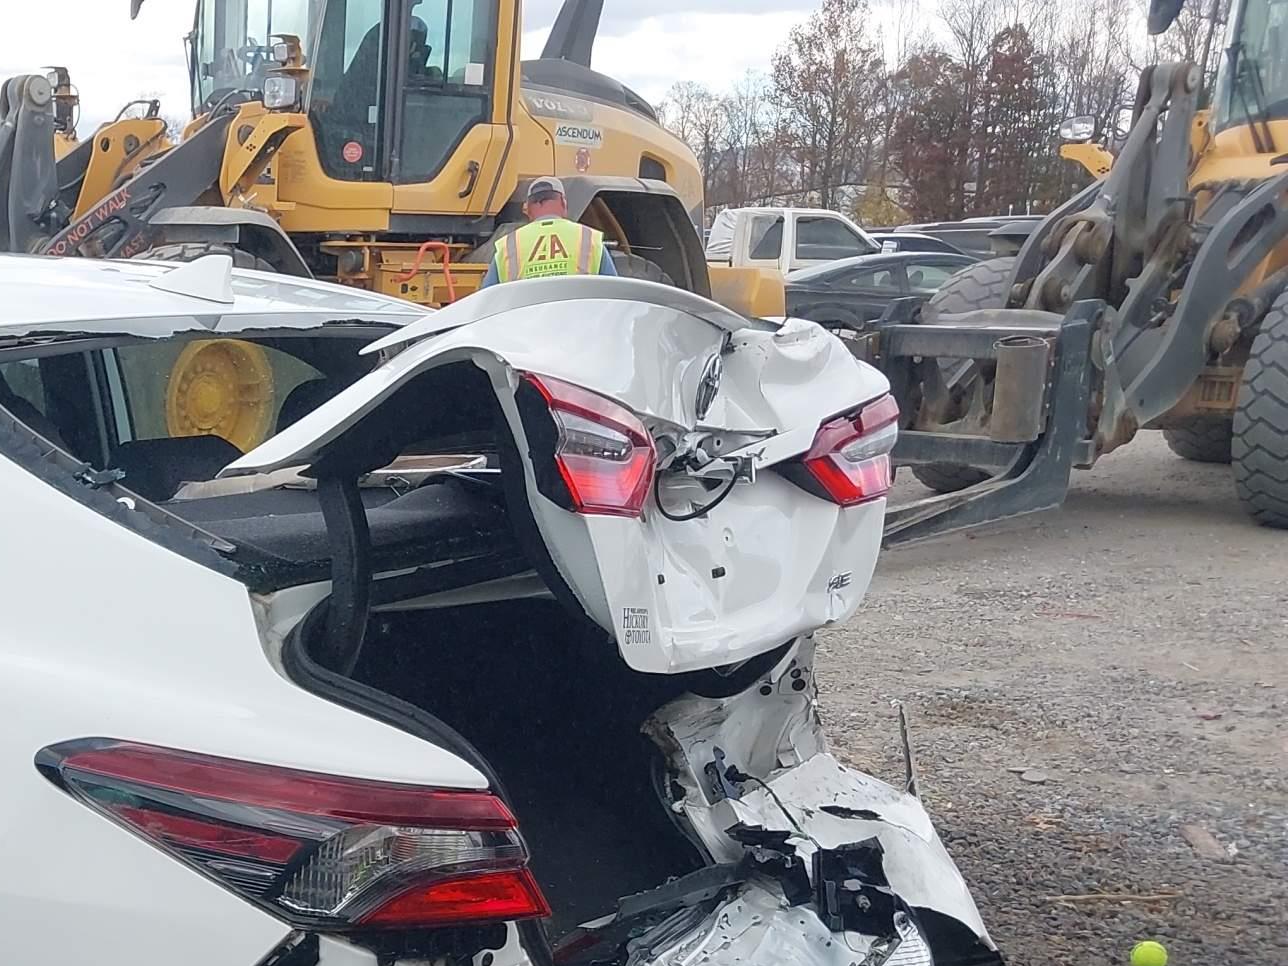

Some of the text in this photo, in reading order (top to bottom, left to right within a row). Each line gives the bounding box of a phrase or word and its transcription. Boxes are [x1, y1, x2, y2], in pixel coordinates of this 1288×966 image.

[531, 97, 588, 113] VOL
[556, 126, 602, 141] ASCENDUM
[67, 216, 94, 244] NOT
[95, 188, 132, 220] WALK
[525, 262, 569, 274] INSURANCE
